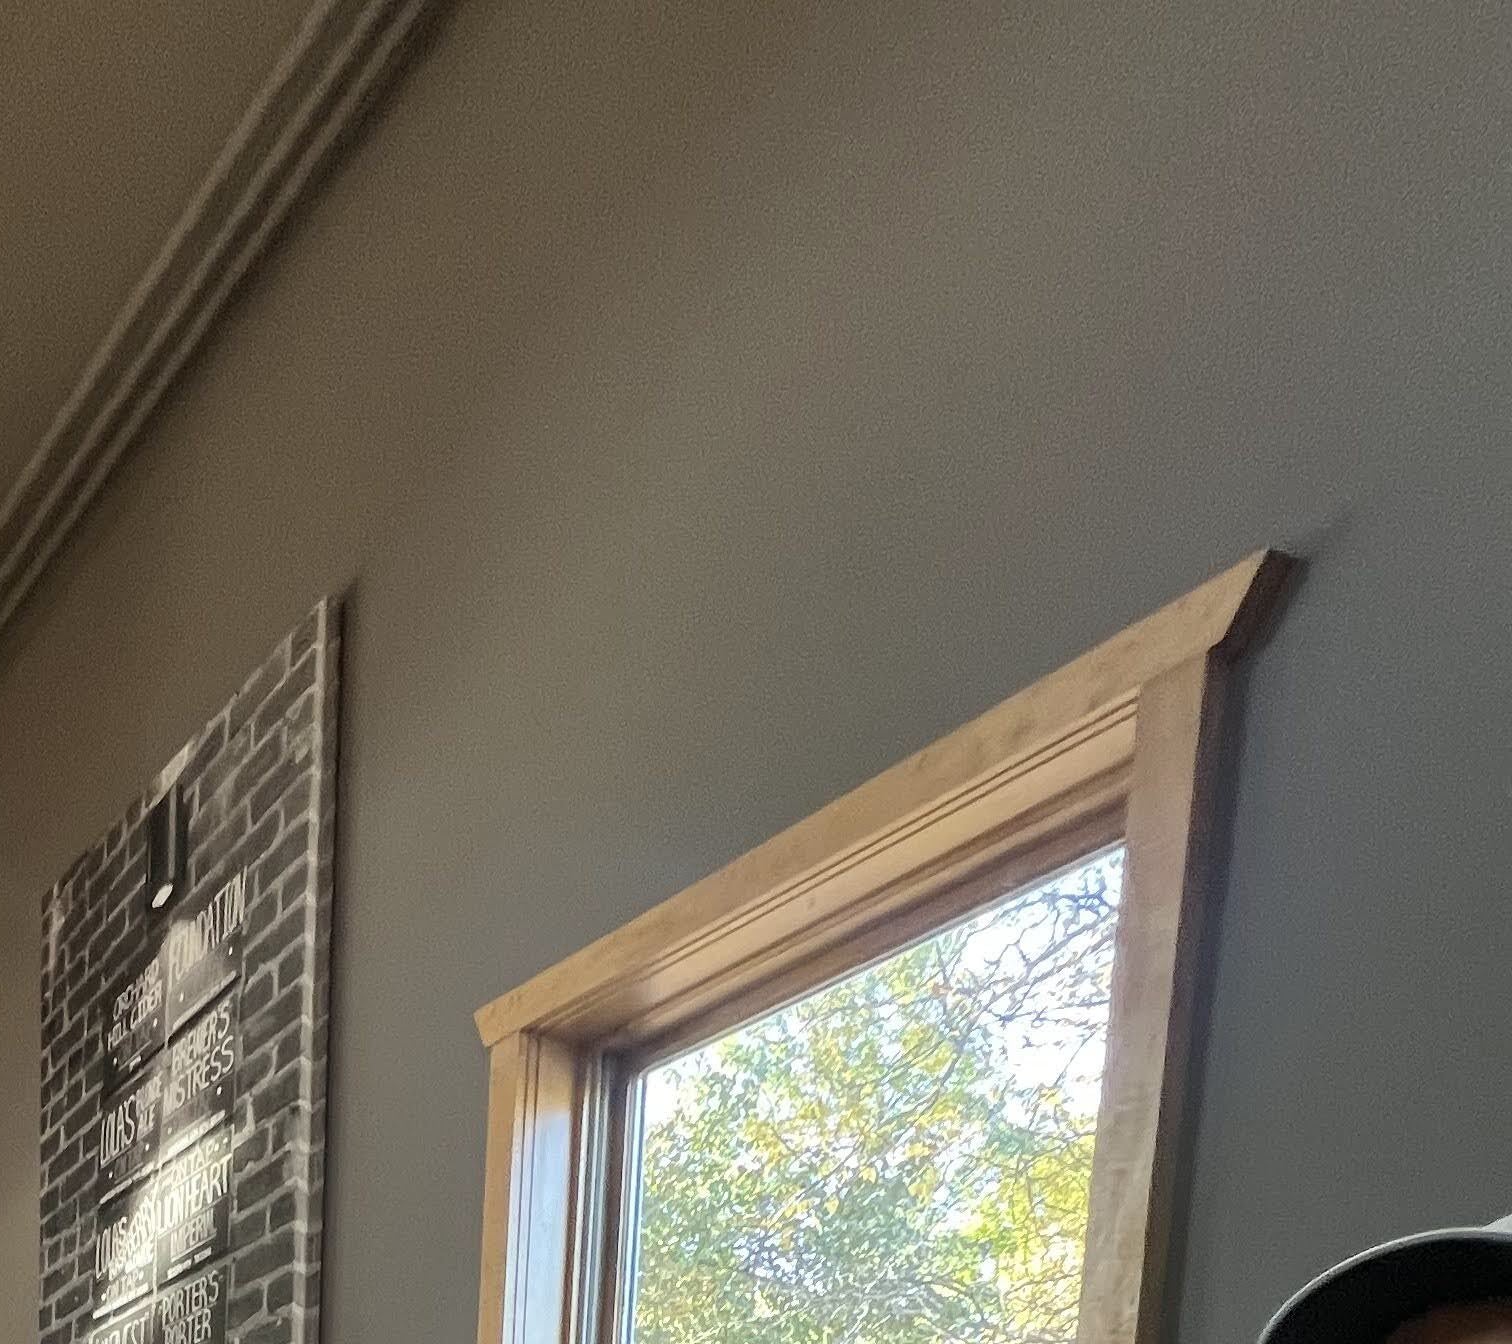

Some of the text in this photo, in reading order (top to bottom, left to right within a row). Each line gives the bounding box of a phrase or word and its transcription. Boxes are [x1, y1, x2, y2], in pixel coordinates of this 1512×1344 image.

[168, 865, 247, 992] FOUNDATION
[113, 957, 160, 1021] ORCHARD
[130, 979, 163, 1031] CIDER
[172, 998, 231, 1074] BREWER'S
[163, 1034, 235, 1117] MISTRESS
[100, 1093, 136, 1166] LOLA'S
[96, 1216, 128, 1280] LOLA'S
